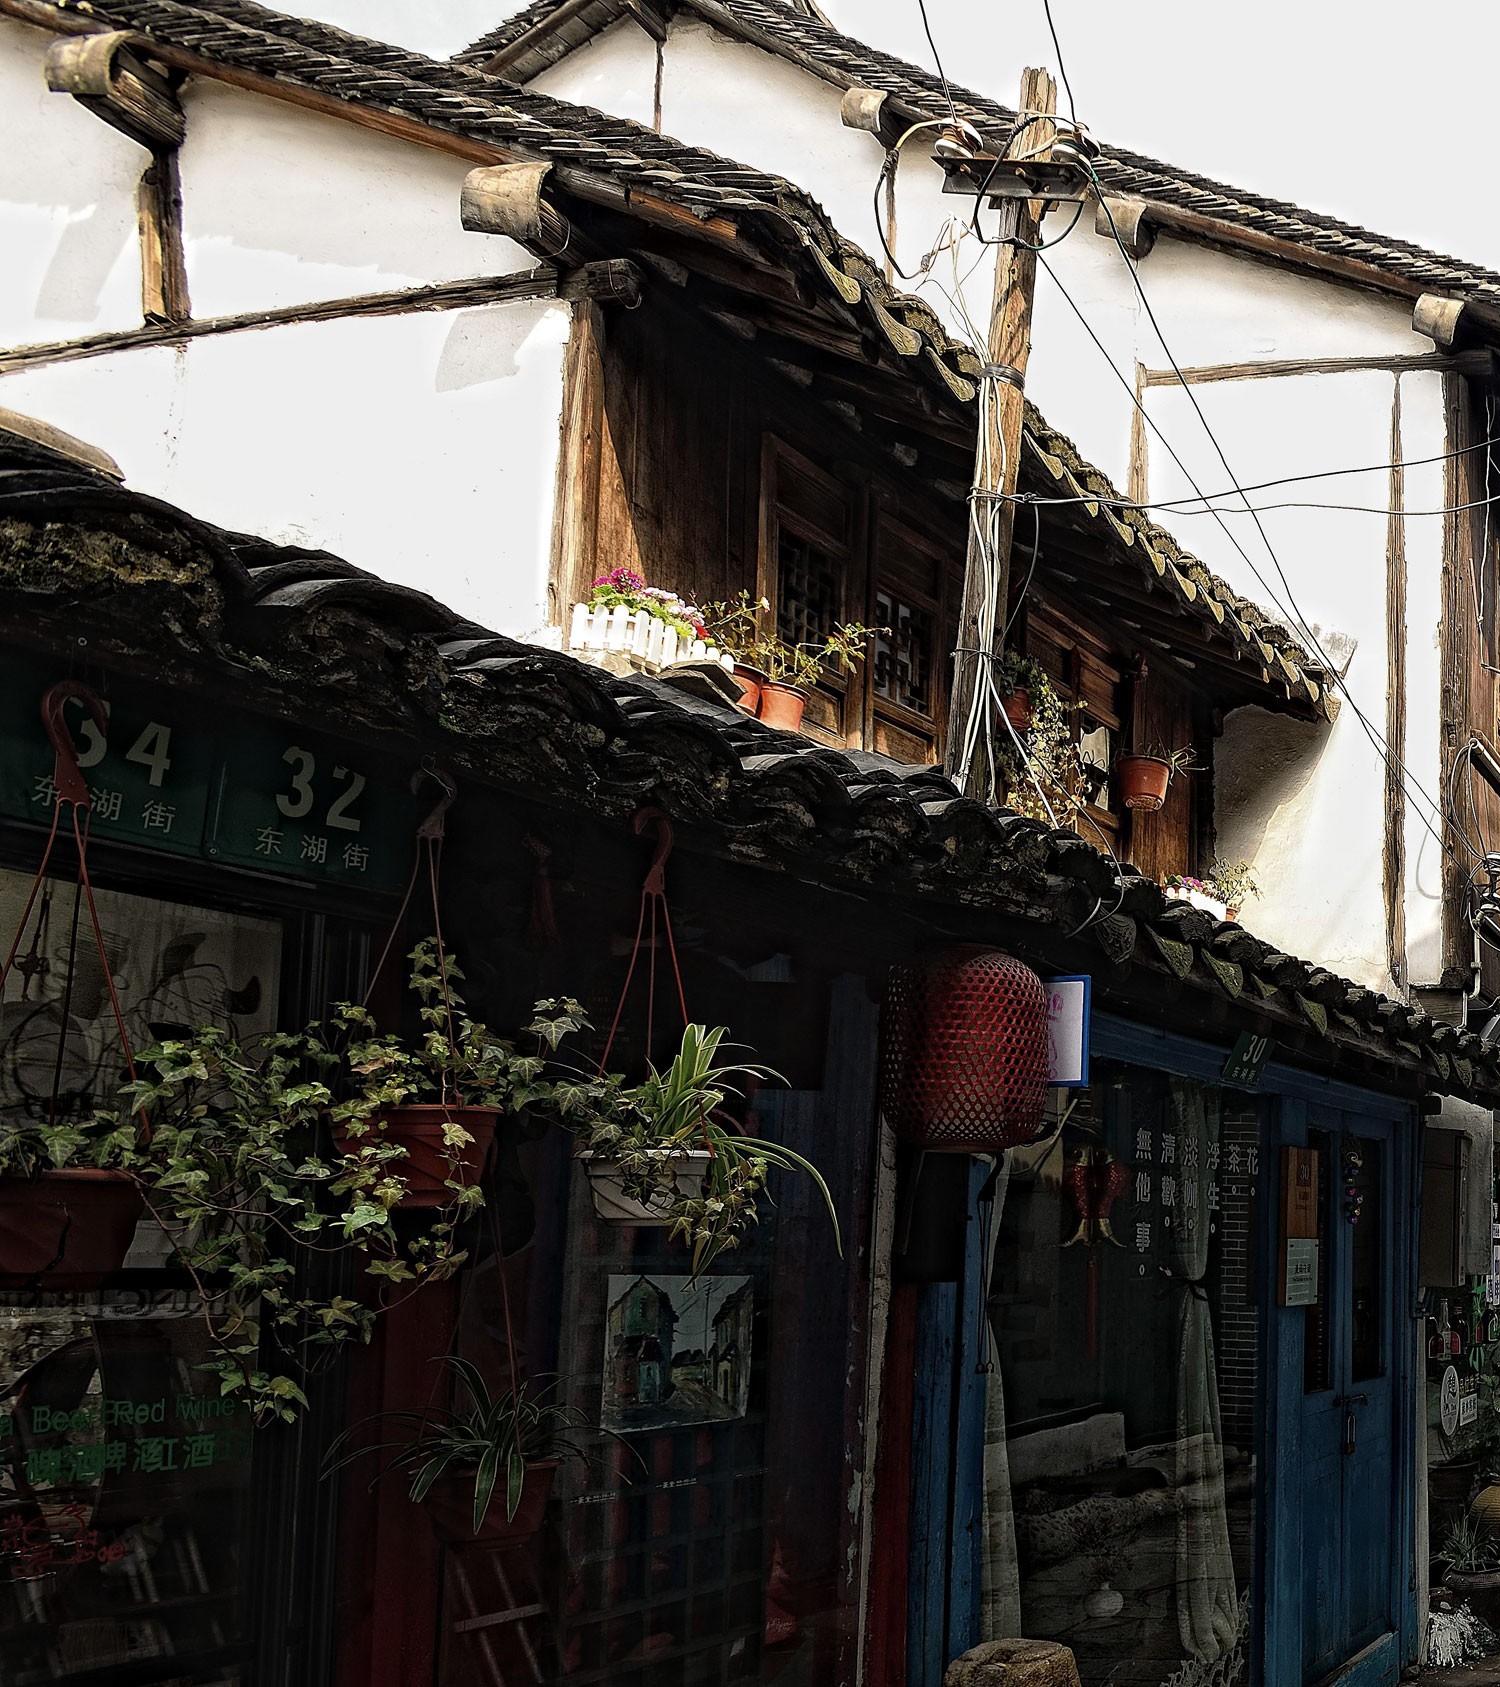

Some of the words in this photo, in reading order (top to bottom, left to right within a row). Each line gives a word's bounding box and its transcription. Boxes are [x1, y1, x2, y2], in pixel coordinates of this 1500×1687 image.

[31, 773, 177, 834] 东湖街
[275, 744, 367, 832] 32
[254, 824, 371, 873] 东湖街
[1242, 1034, 1268, 1064] 30
[1300, 1164, 1310, 1180] 30
